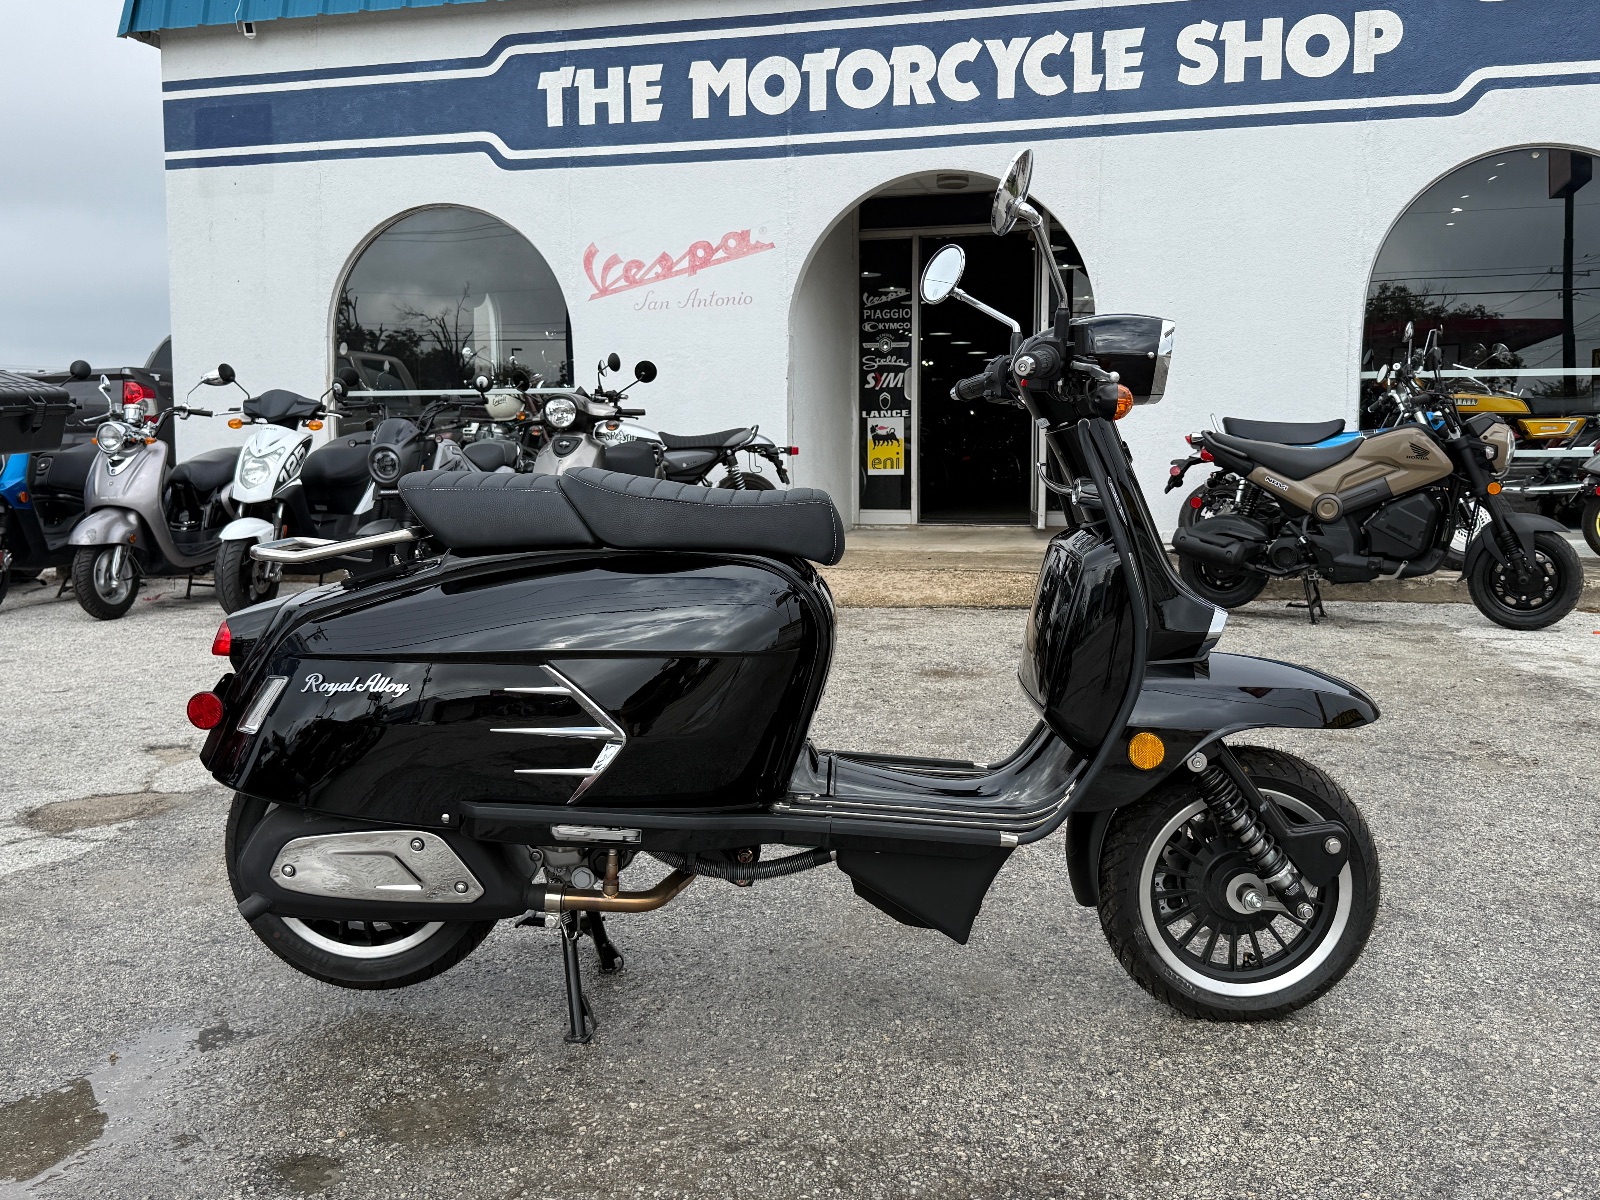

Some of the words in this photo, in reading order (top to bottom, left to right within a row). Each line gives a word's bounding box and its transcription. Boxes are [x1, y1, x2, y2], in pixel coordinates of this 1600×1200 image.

[537, 64, 663, 127] THE
[689, 27, 1146, 119] MOTORCYCLE
[1177, 9, 1404, 86] SHOP
[583, 229, 775, 301] Vespa
[634, 290, 670, 311] San
[677, 288, 753, 309] Antonio
[863, 290, 910, 307] Vespa
[863, 309, 911, 319] PIAGGIO
[879, 322, 911, 330] KYMCO
[862, 355, 909, 370] Stella
[864, 372, 905, 390] SYM
[862, 409, 910, 418] LANCE
[279, 444, 306, 482] 125
[872, 451, 900, 469] eni
[301, 673, 359, 697] Royal
[356, 673, 410, 698] Alloy
